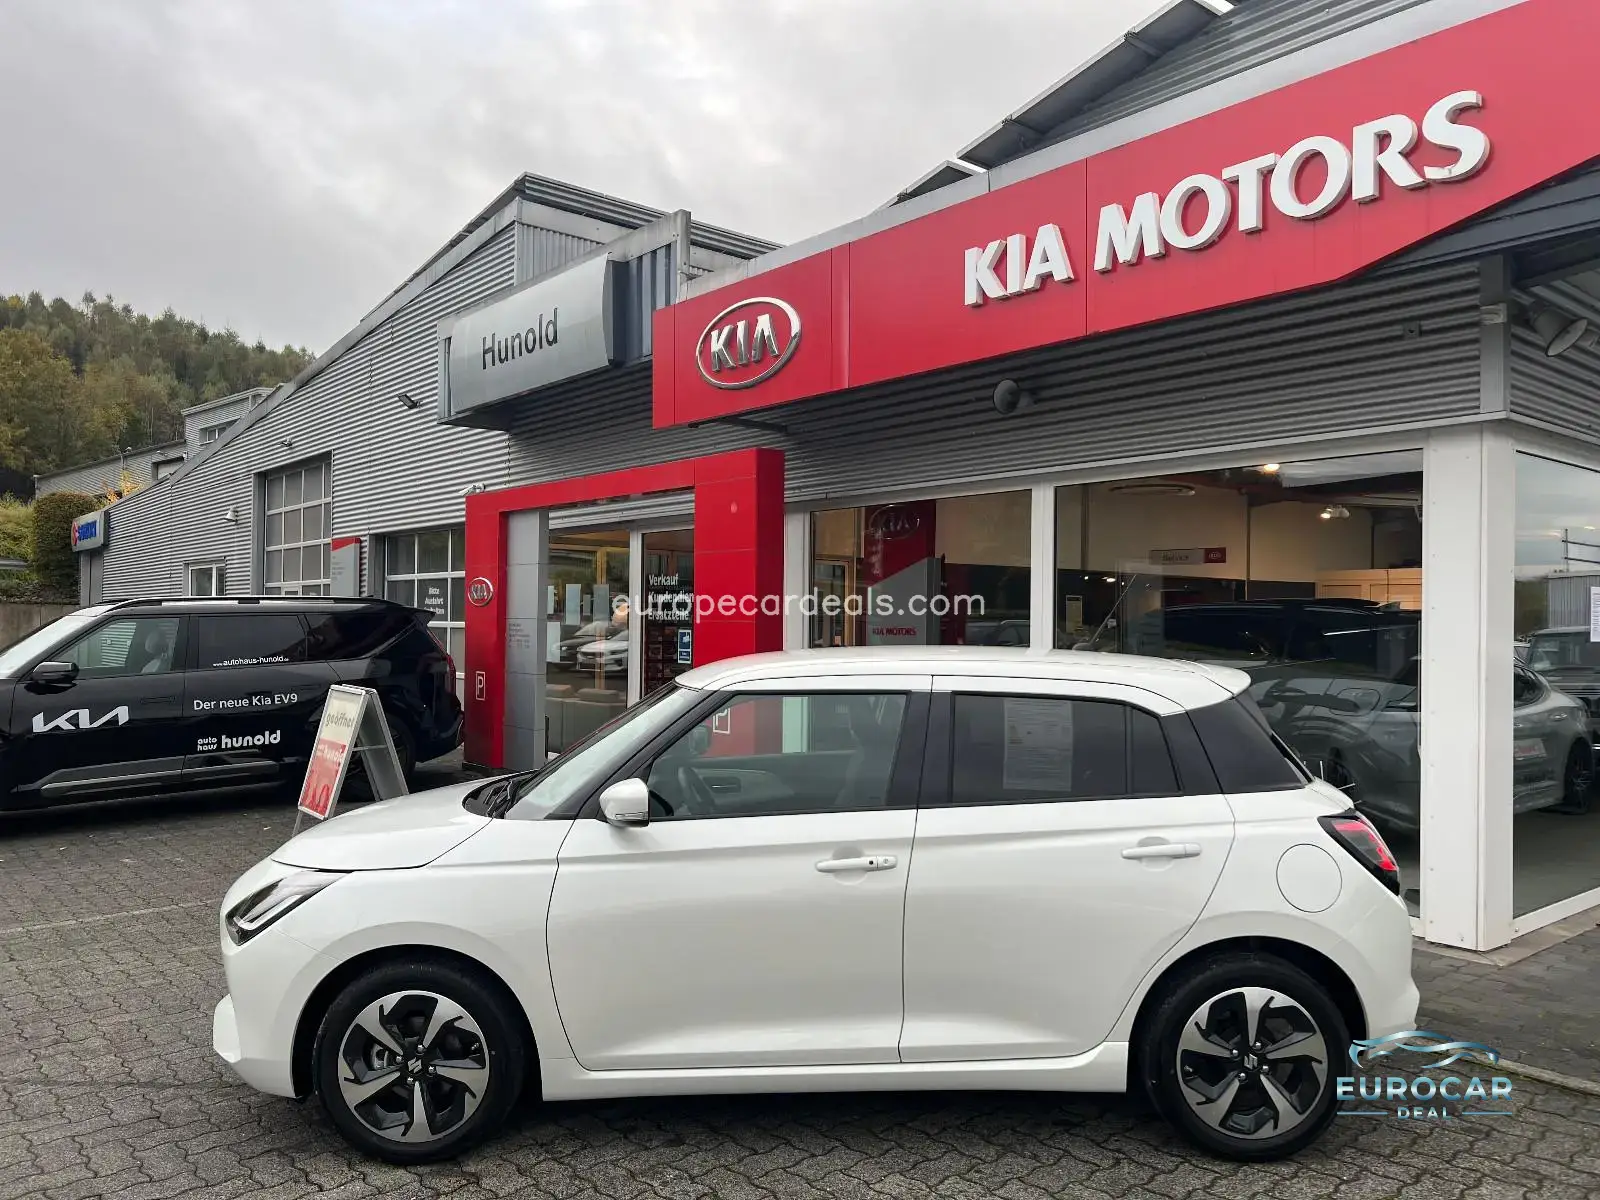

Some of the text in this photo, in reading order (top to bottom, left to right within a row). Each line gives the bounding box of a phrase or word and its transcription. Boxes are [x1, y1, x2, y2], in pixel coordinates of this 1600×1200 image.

[964, 90, 1490, 307] KIA MOTORS
[482, 307, 559, 370] Hunold
[709, 313, 780, 372] KIA
[648, 573, 679, 586] Verkauf
[472, 583, 488, 600] KIA
[648, 608, 689, 621] Ersatzteile
[885, 626, 917, 636] MOTORS
[477, 675, 484, 695] P
[193, 693, 298, 711] Der neue Kia EV9
[32, 705, 130, 733] KIA
[197, 736, 218, 746] auto
[197, 743, 218, 752] haus
[221, 729, 281, 749] hunold
